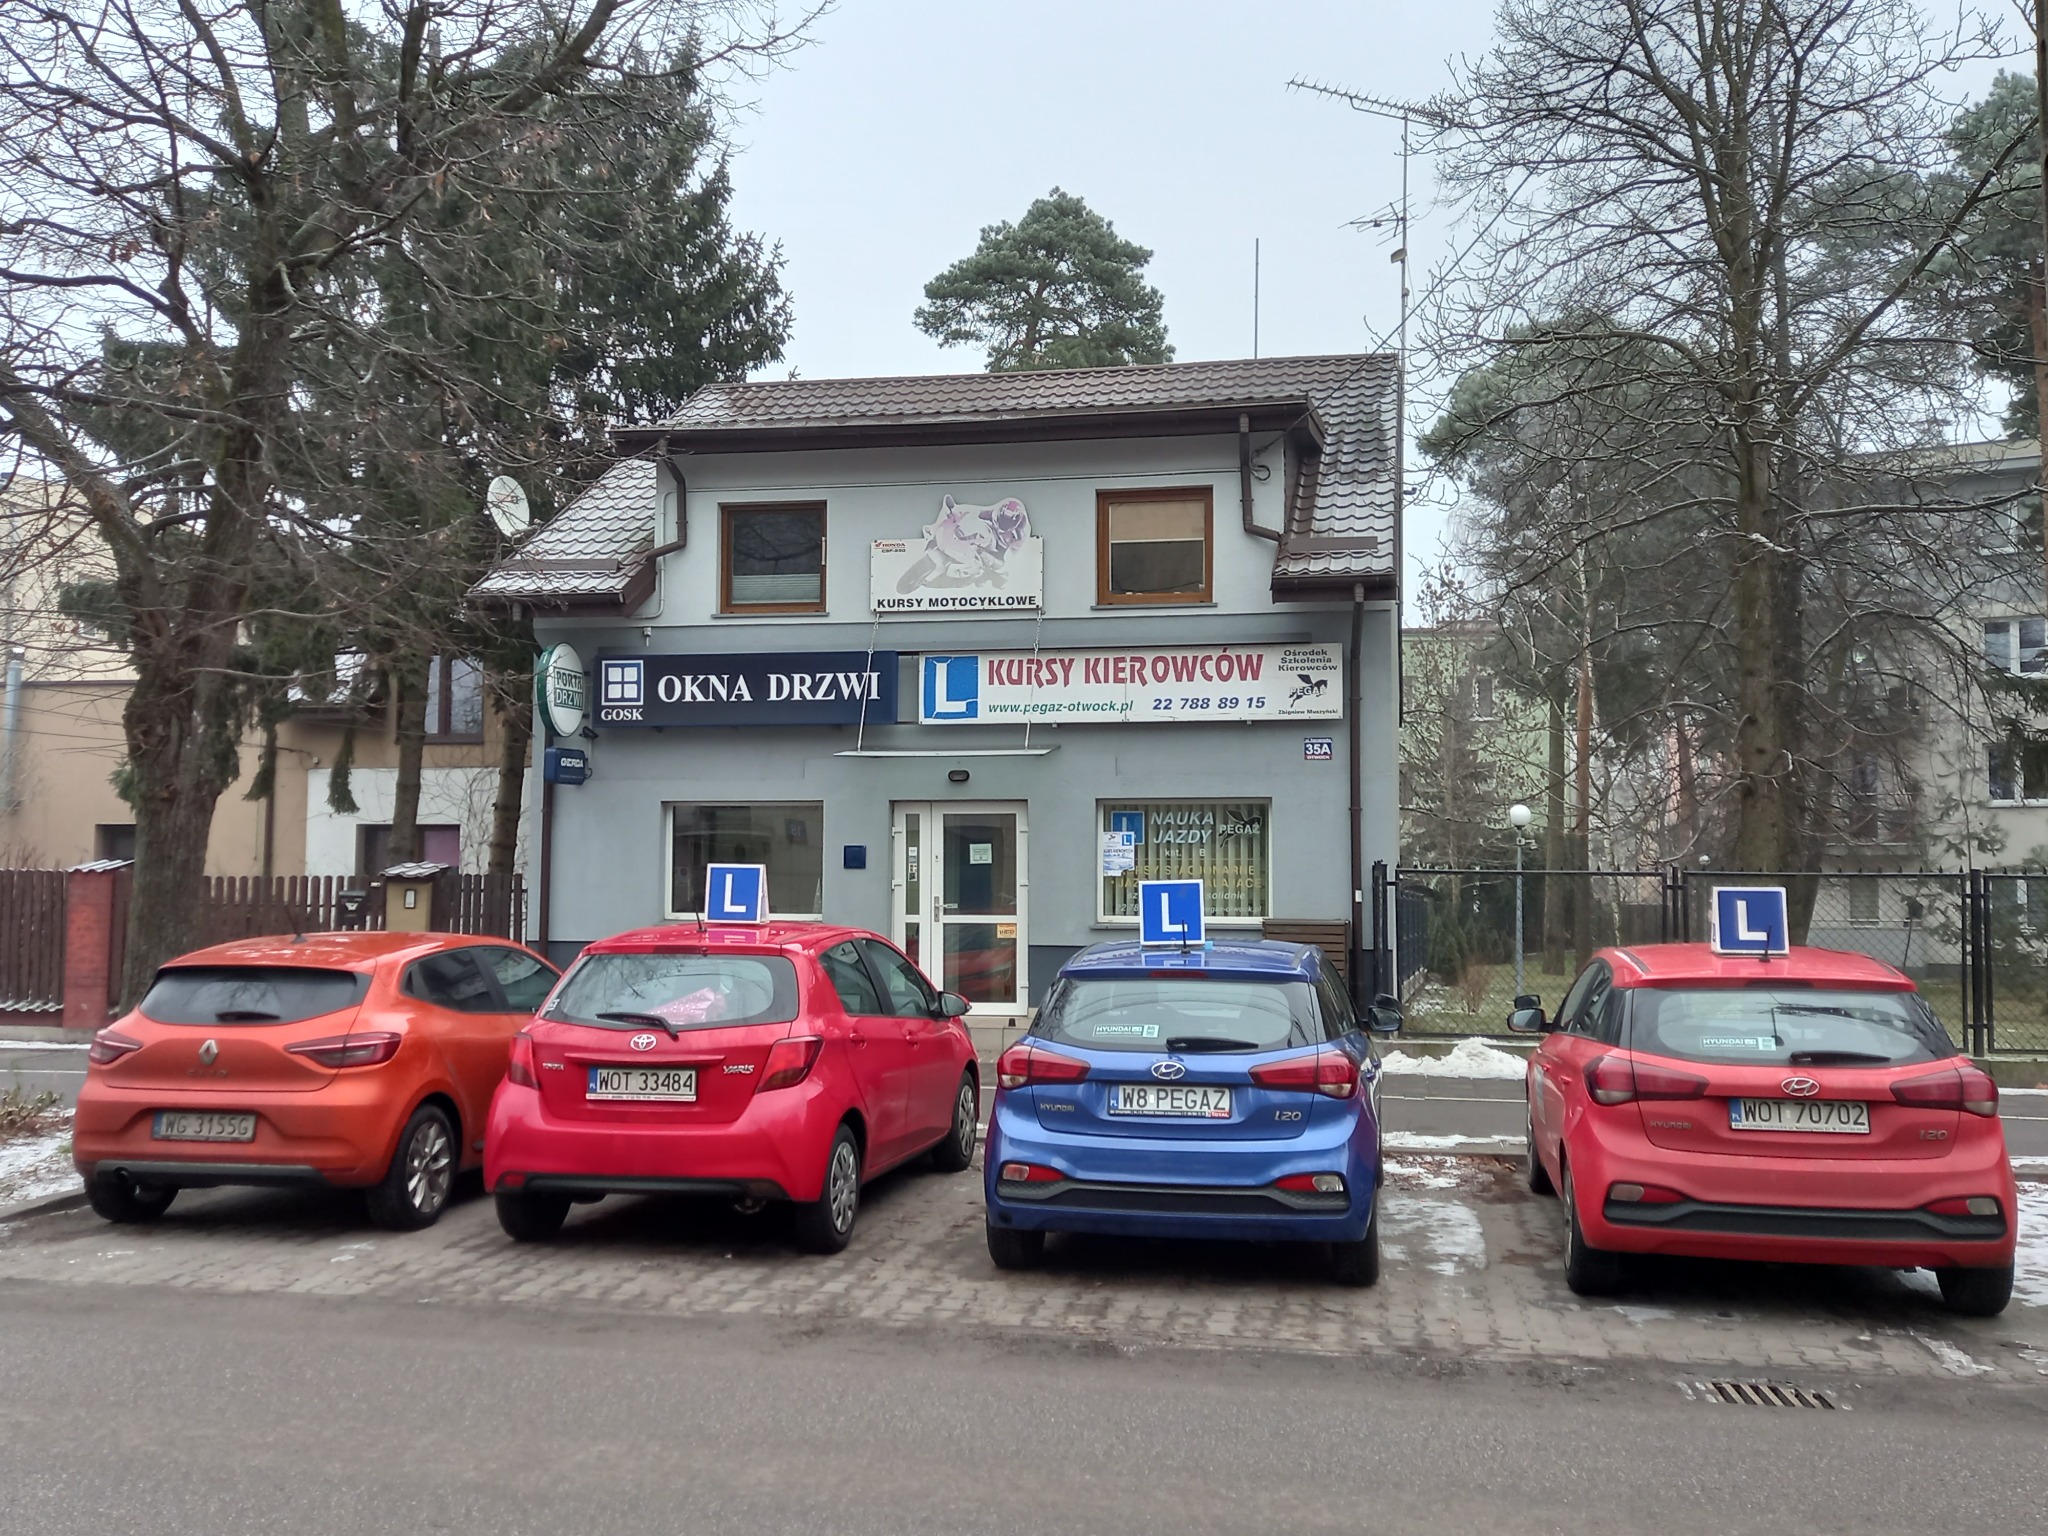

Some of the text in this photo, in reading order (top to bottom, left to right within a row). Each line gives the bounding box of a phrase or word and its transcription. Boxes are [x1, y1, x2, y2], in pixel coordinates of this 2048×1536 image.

[877, 596, 1037, 608] KURSY MOTOCYKLOWE
[1281, 656, 1332, 664] Szkolenia
[1283, 649, 1328, 657] Ośrodek
[988, 647, 1264, 689] KURSY KIEROWCÓW
[1278, 664, 1338, 672] Kierowców
[657, 671, 881, 702] OKNA DRZWI
[556, 689, 582, 707] DRZWI
[1152, 696, 1266, 710] 22 788 89 15
[601, 708, 643, 721] GOSK
[988, 700, 1134, 716] www.pegaz-otwock.pl
[1306, 743, 1331, 755] 35A
[1151, 811, 1214, 826] NAUKA
[1153, 829, 1213, 844] JAZDY
[1219, 822, 1260, 835] PEGAZ
[724, 873, 747, 913] L
[1160, 892, 1188, 933] L
[1736, 900, 1768, 941] L
[599, 1071, 632, 1091] WOT
[639, 1072, 693, 1093] 33484
[1122, 1087, 1148, 1108] W8
[1156, 1088, 1226, 1111] PEGAZ
[1742, 1100, 1786, 1123] WOT
[1793, 1101, 1867, 1126] 70702
[165, 1115, 248, 1136] WG 3155G
